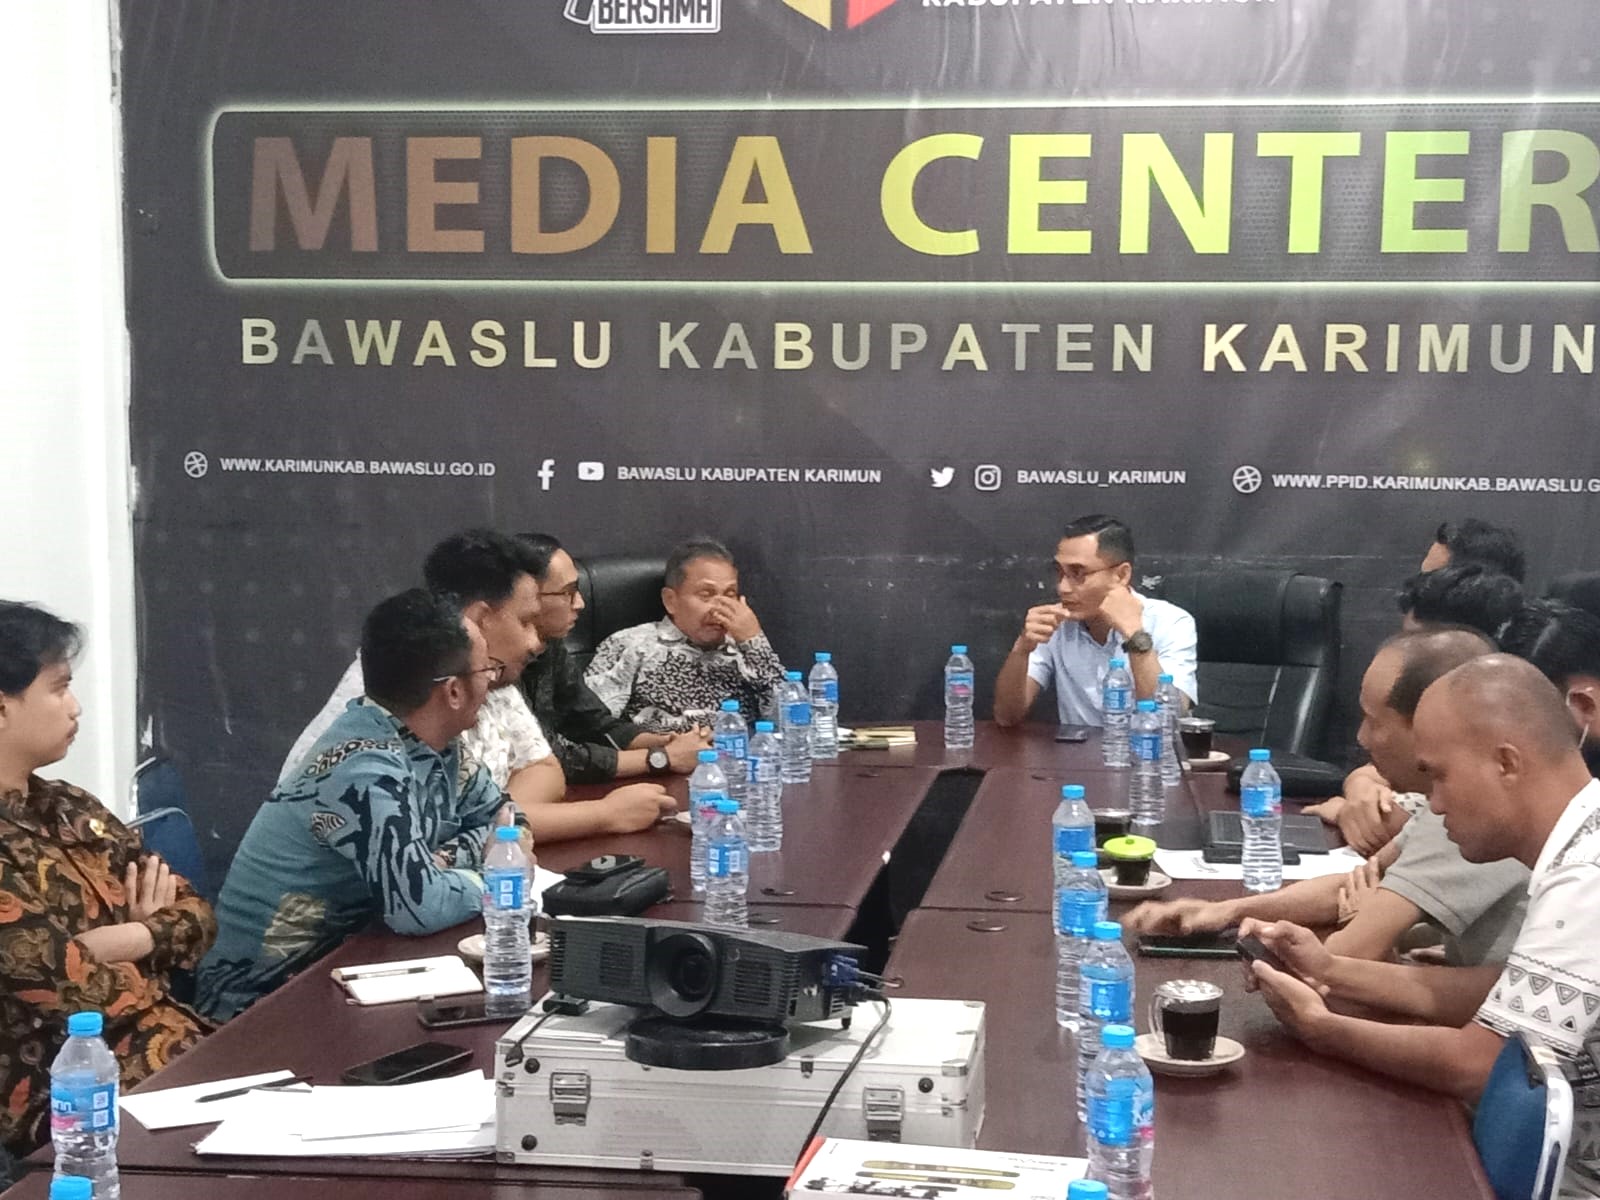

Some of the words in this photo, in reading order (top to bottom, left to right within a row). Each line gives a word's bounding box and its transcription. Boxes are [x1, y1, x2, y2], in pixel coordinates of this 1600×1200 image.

[598, 0, 713, 24] BERSAMA
[249, 136, 813, 254] MEDIA
[881, 129, 1600, 255] CENTER
[241, 319, 611, 368] BAWASLU
[658, 321, 1153, 372] KABUPATEN
[1203, 322, 1595, 374] KARIMUN
[220, 457, 496, 477] WWW.KARIMUNKAB.BAWASLU.GO.ID
[617, 466, 697, 481] BAWASLU
[701, 468, 800, 482] KABUPATEN
[804, 469, 882, 483] KARIMUN
[1017, 470, 1187, 487] BAWASLU_KARIMUN
